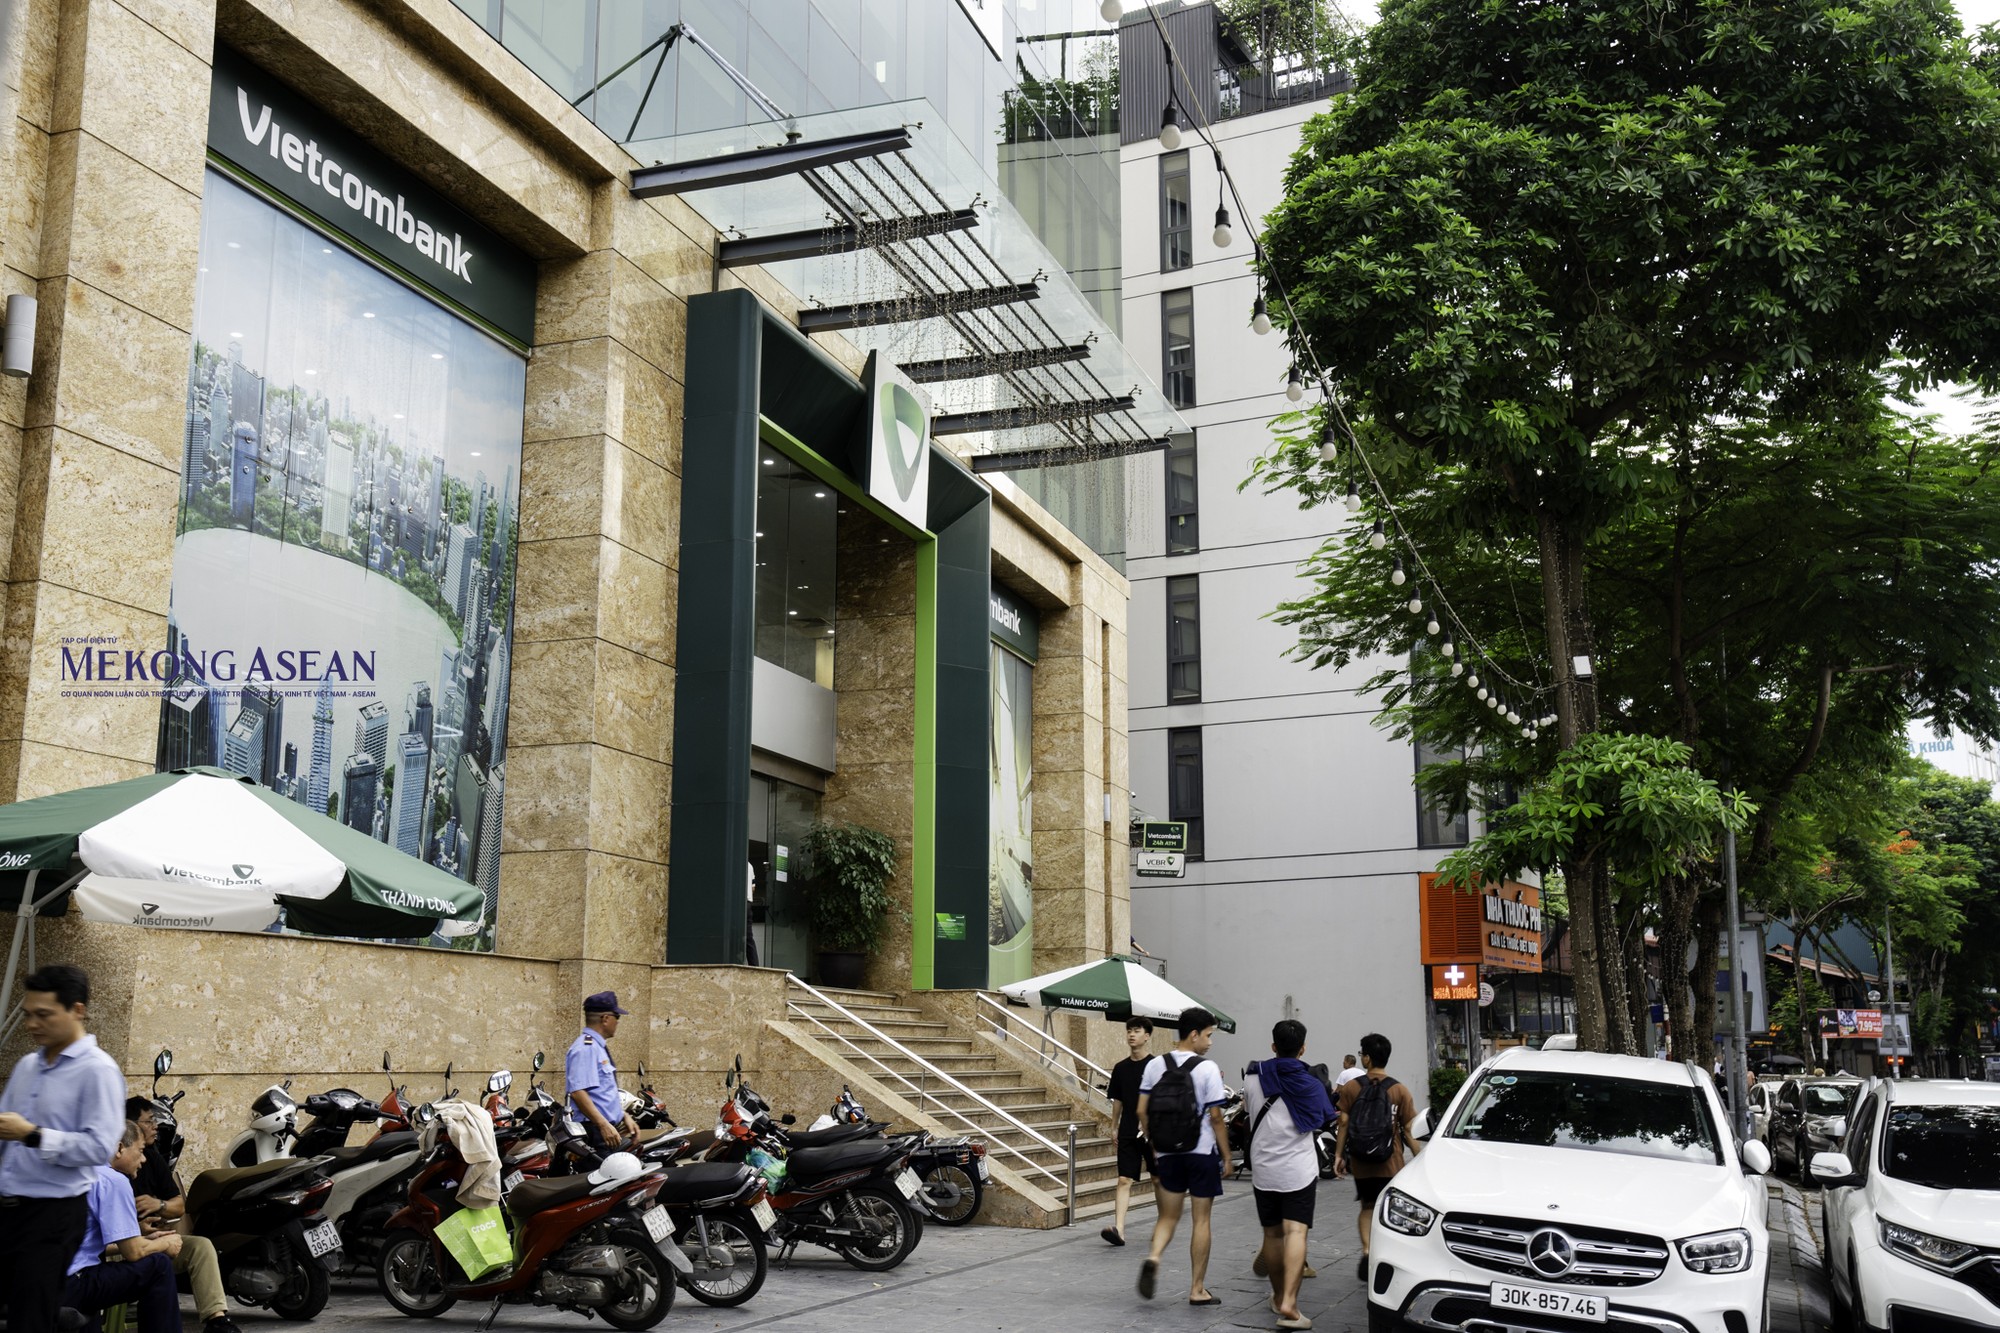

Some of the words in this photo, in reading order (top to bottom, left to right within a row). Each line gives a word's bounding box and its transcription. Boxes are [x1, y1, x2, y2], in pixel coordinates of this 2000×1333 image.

[237, 85, 473, 284] Vietcombank
[1919, 740, 1955, 753] KHOA
[1147, 832, 1182, 840] Vietcombank
[162, 863, 263, 886] Vietcombank
[380, 889, 425, 908] THÀNH
[1060, 997, 1086, 1006] THÀNH
[1086, 999, 1109, 1009] CÔNG
[308, 1224, 333, 1242] 29-G1
[471, 1220, 497, 1234] crocs
[311, 1234, 340, 1255] 395.48
[1501, 1288, 1597, 1315] 30K-857.46
